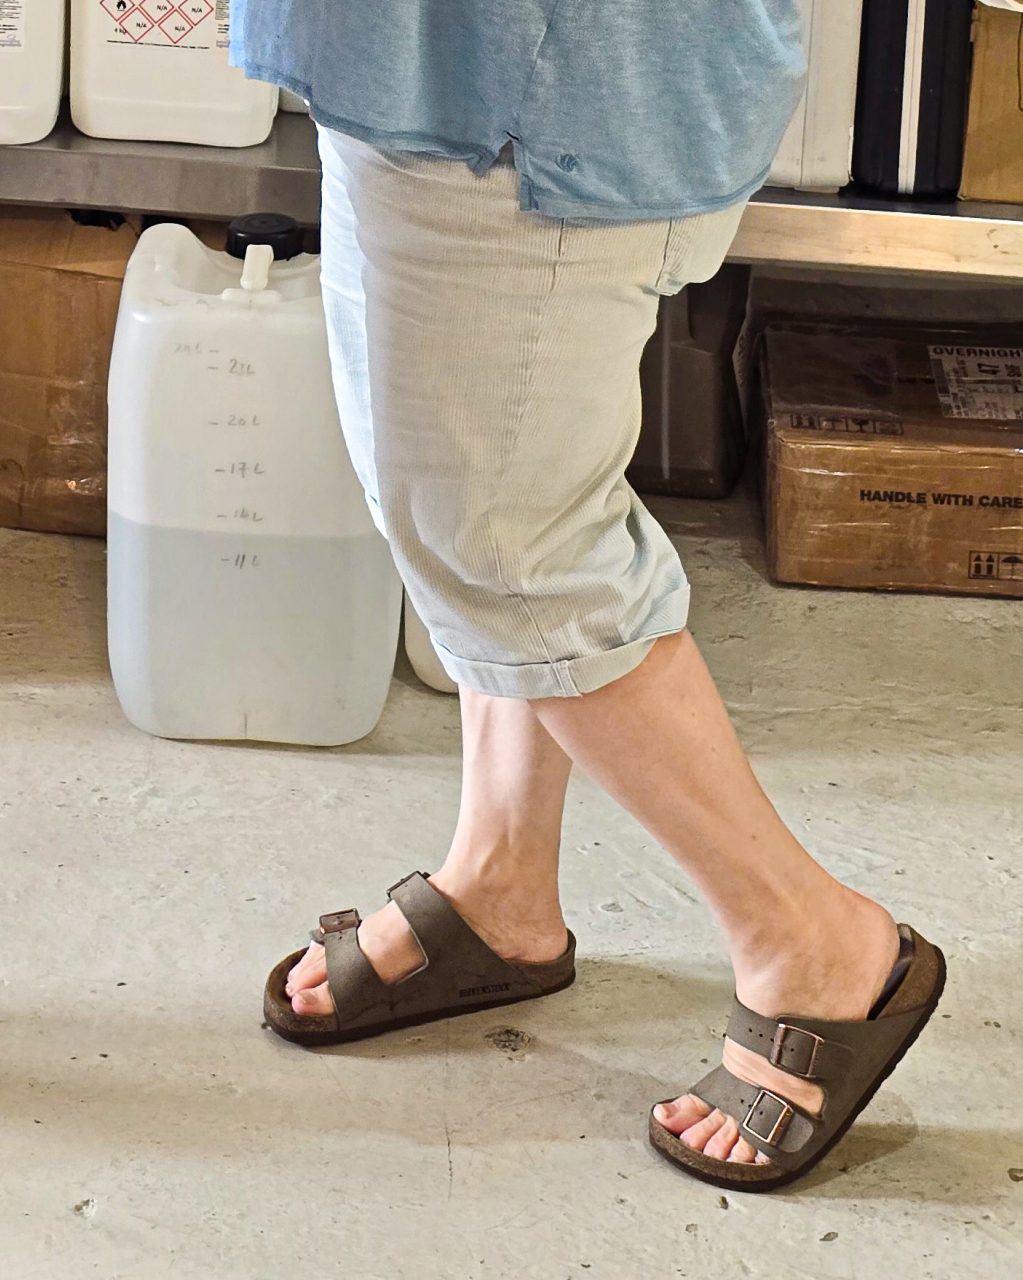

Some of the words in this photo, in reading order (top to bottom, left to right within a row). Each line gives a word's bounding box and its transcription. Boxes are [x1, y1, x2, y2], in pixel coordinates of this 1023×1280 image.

[859, 489, 927, 505] HANDLE
[931, 492, 974, 507] WITH
[978, 495, 1023, 509] CARE
